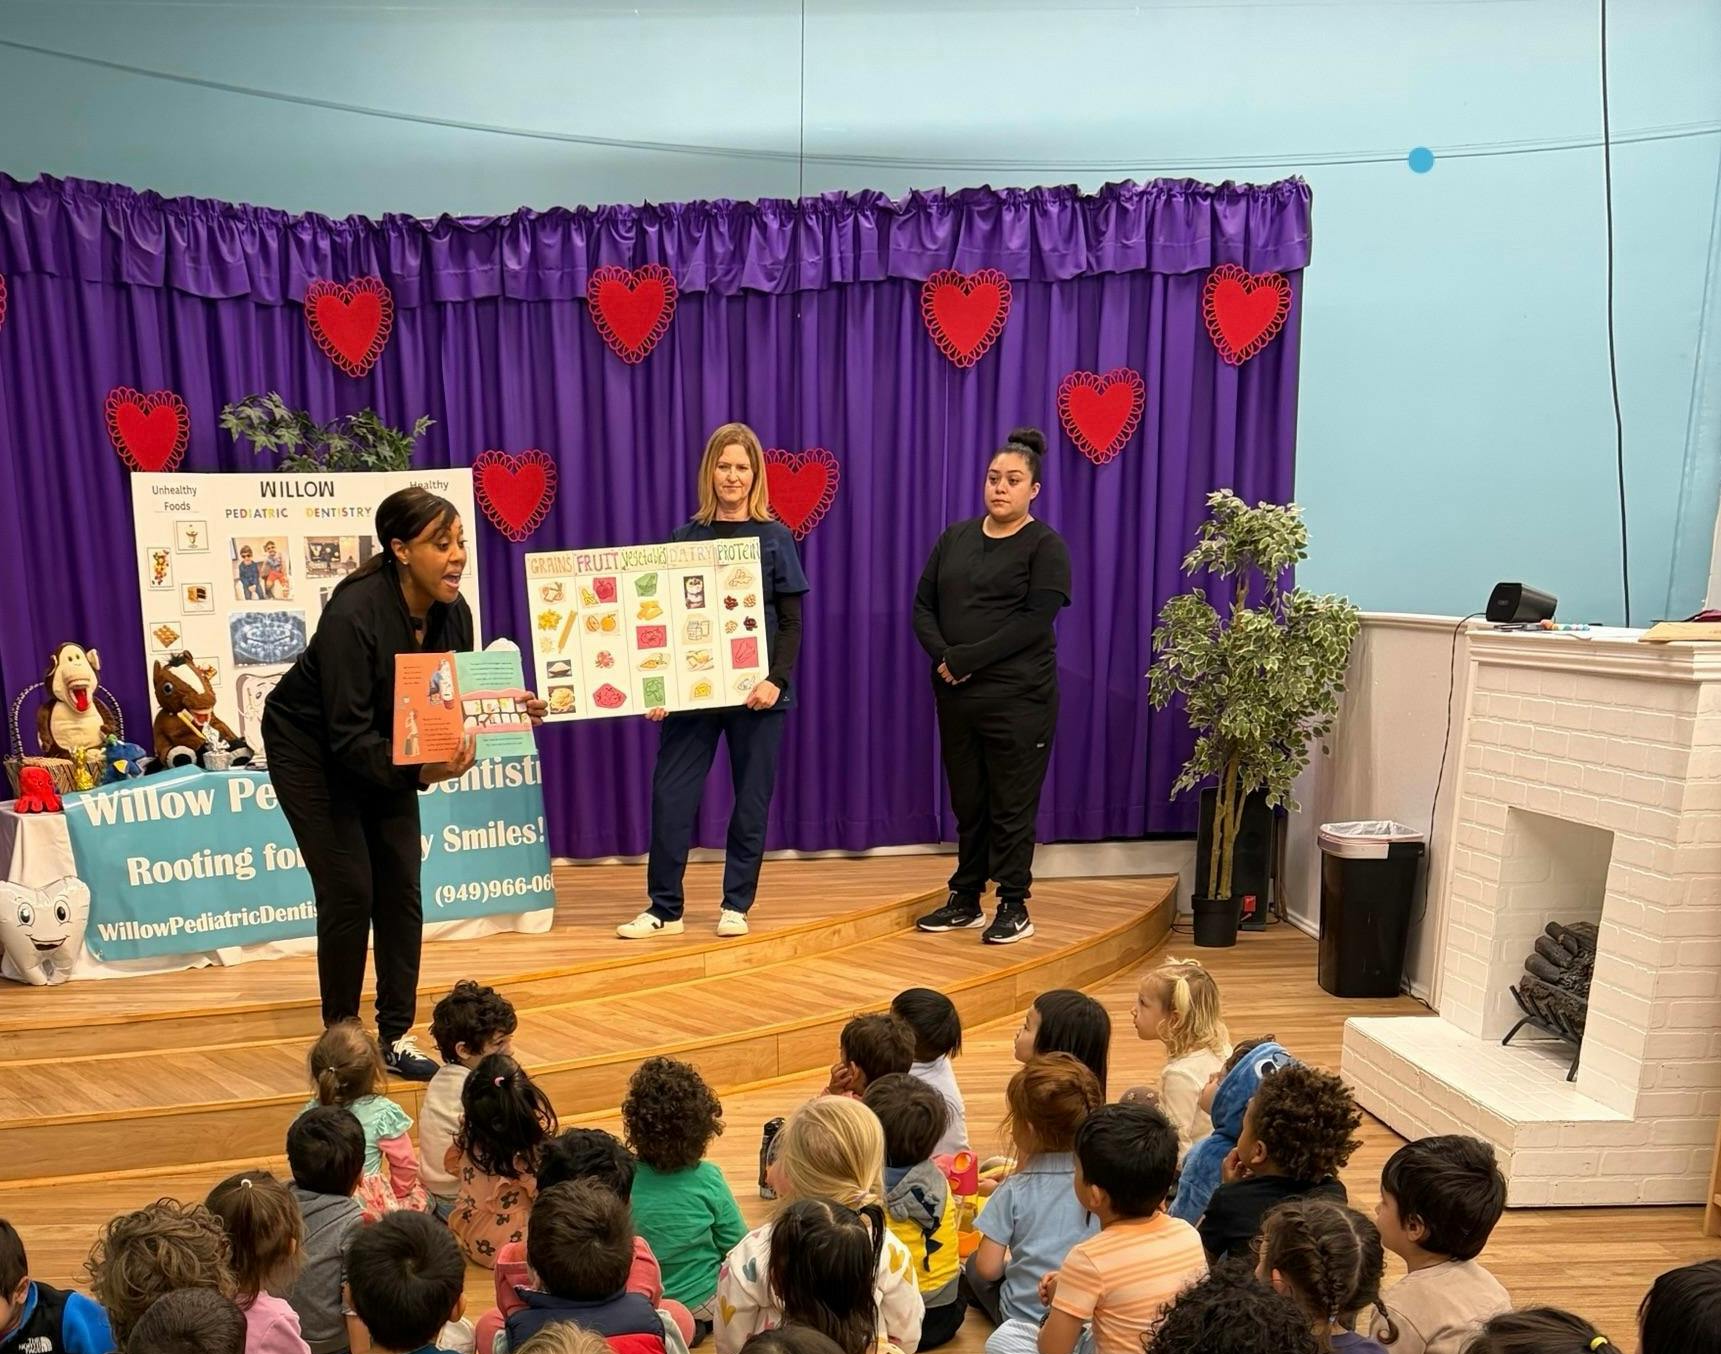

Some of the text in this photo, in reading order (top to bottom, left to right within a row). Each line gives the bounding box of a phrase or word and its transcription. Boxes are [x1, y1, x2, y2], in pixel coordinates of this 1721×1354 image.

[152, 485, 197, 497] Unhealthy
[260, 481, 335, 498] WILLOW
[164, 501, 191, 511] Foods
[225, 507, 372, 519] PEDIATRIC DENTISTRY
[530, 556, 572, 574] GRAINS
[576, 551, 619, 573] FRUIT
[669, 544, 714, 563] DAIRY
[80, 786, 215, 827] Willow
[127, 848, 257, 887] Rooting
[442, 816, 546, 853] Smiles!
[435, 872, 555, 908] (949)966-06
